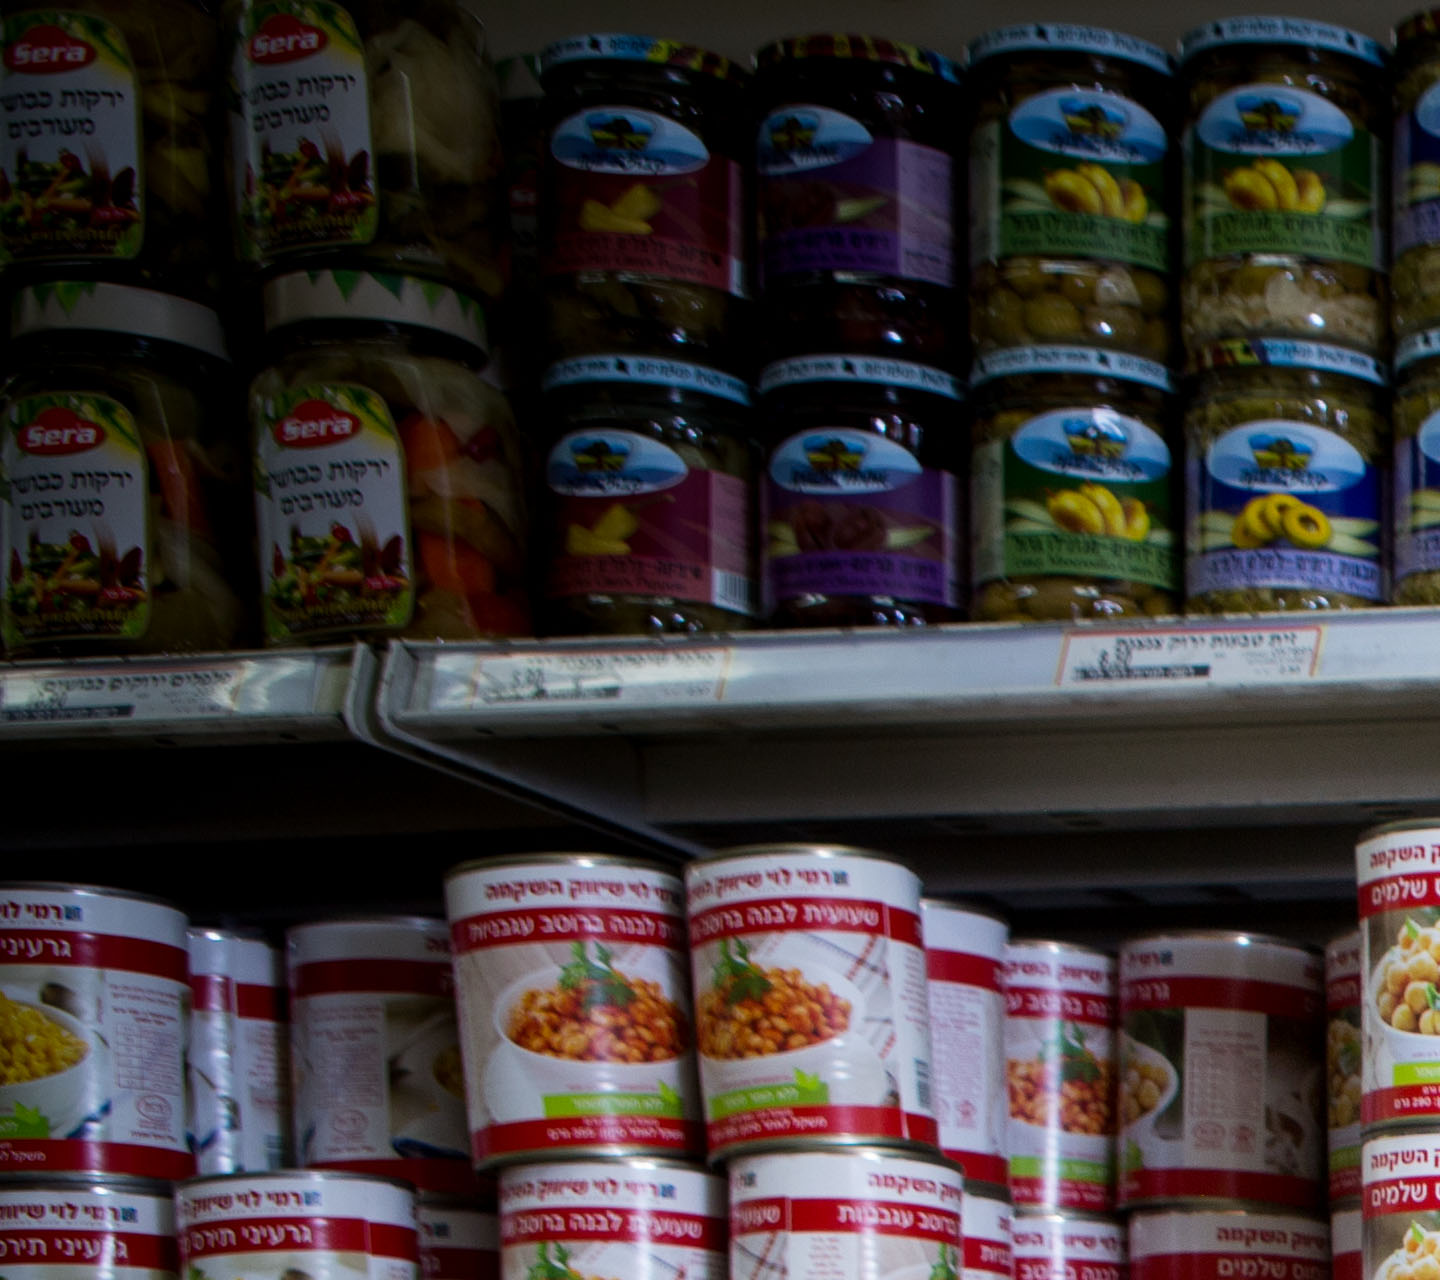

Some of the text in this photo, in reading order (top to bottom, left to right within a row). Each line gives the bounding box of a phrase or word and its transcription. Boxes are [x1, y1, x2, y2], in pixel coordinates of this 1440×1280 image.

[282, 416, 353, 442] Sera
[329, 459, 389, 484] ירקות
[281, 489, 364, 515] מעורבים
[1370, 846, 1426, 871] השקמה
[1371, 878, 1429, 906] שלמים
